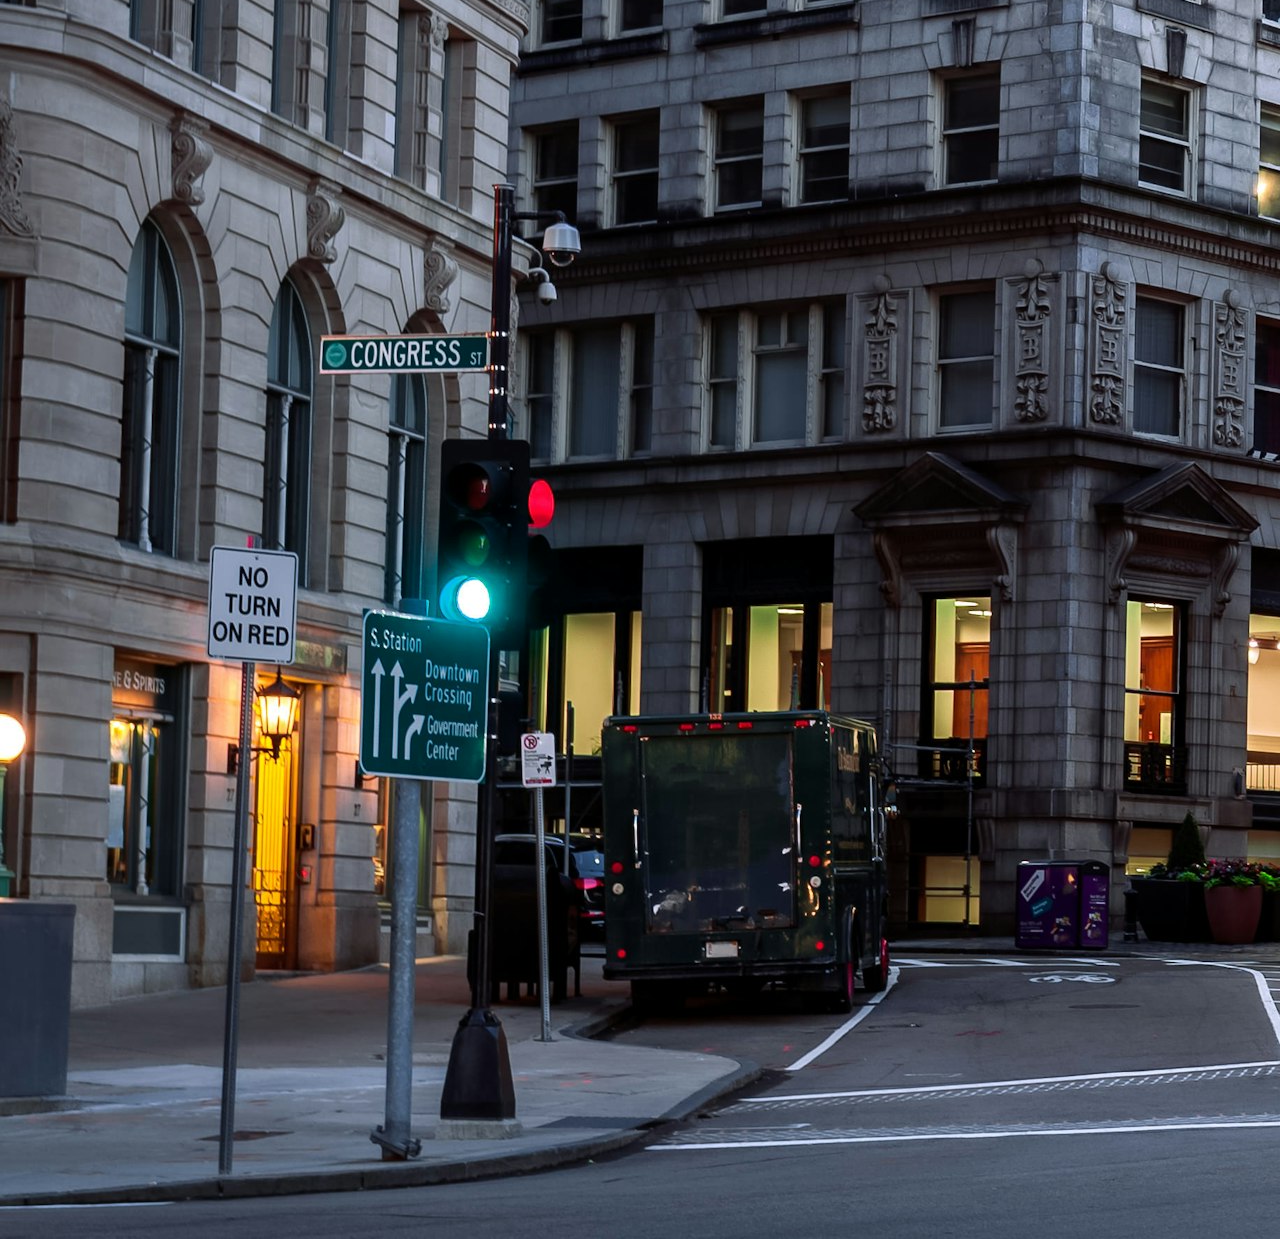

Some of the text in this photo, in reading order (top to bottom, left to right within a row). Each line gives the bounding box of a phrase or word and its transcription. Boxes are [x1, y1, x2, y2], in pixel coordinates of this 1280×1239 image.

[351, 340, 483, 368] CONGRESS ST
[239, 566, 268, 588] NO
[225, 593, 281, 618] TURN
[213, 621, 289, 646] ON RED
[370, 628, 422, 653] S. Station
[124, 670, 131, 689] &
[425, 659, 480, 684] Downtown
[425, 682, 472, 711] Crossing
[427, 715, 479, 738] Government
[426, 740, 459, 761] Center
